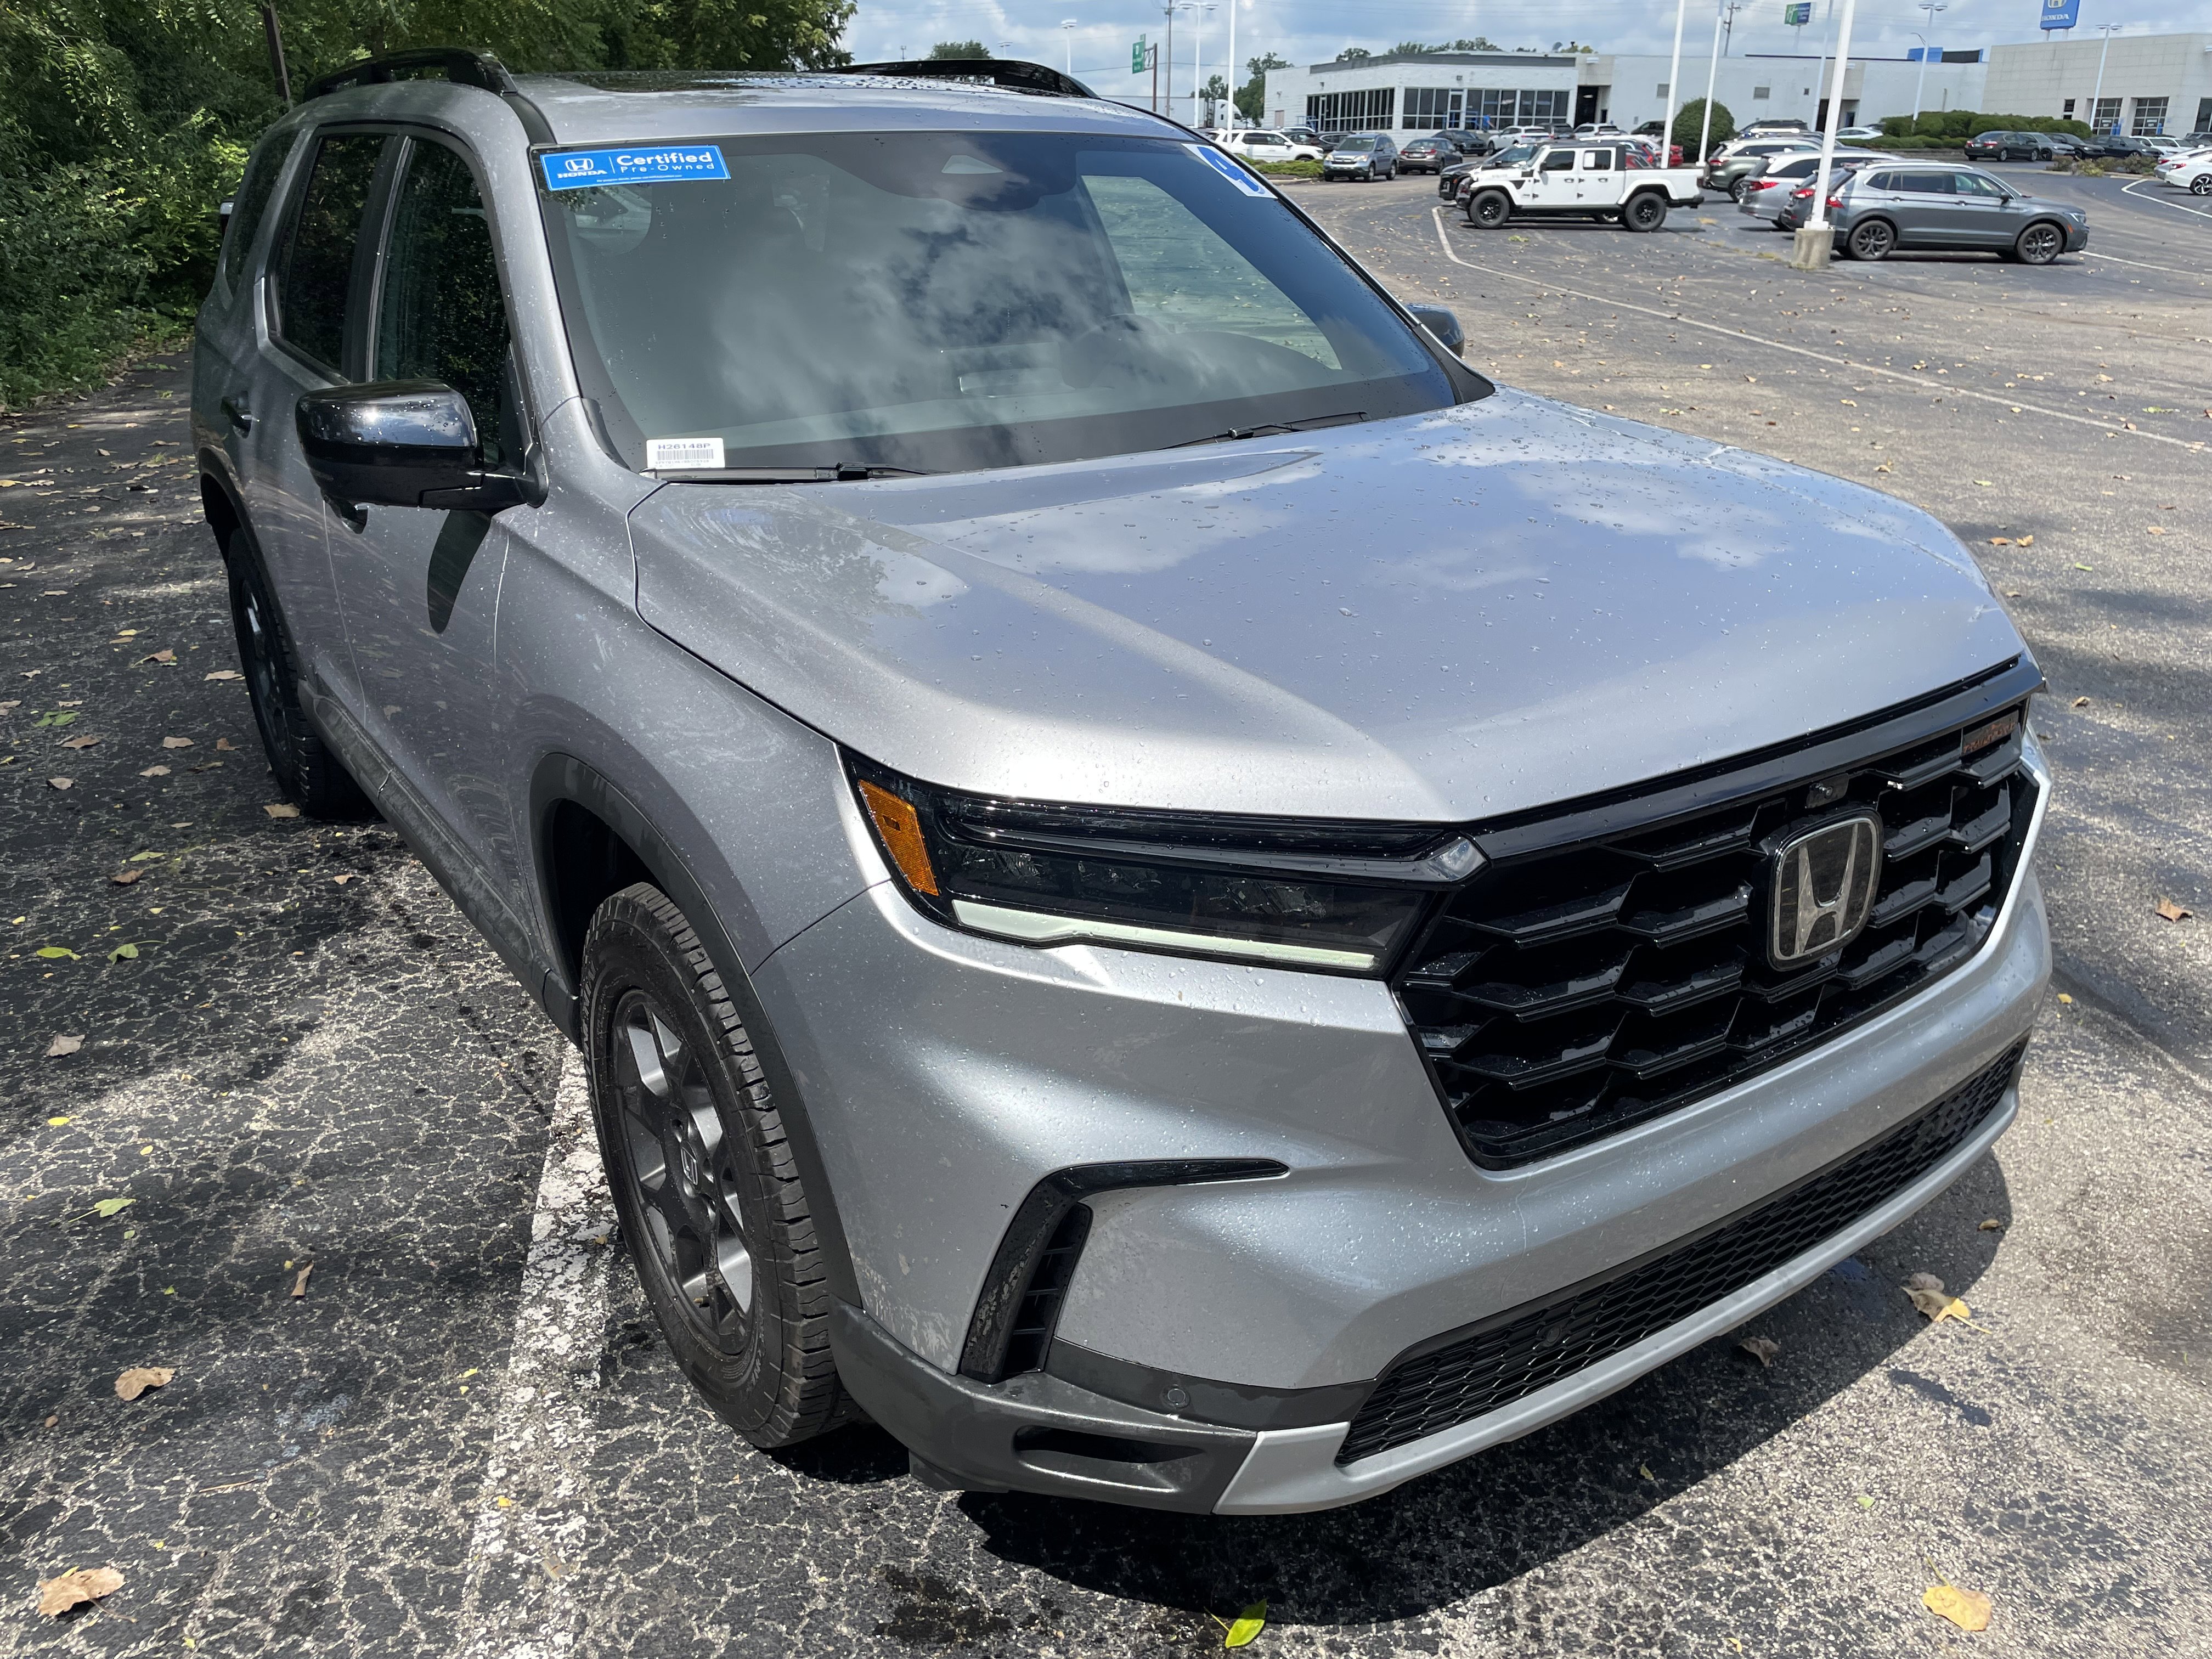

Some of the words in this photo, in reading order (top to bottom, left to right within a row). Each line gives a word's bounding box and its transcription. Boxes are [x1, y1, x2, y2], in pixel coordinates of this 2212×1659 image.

[617, 151, 713, 166] Certified
[620, 162, 715, 173] Pre-Owned
[557, 170, 608, 178] HONDA
